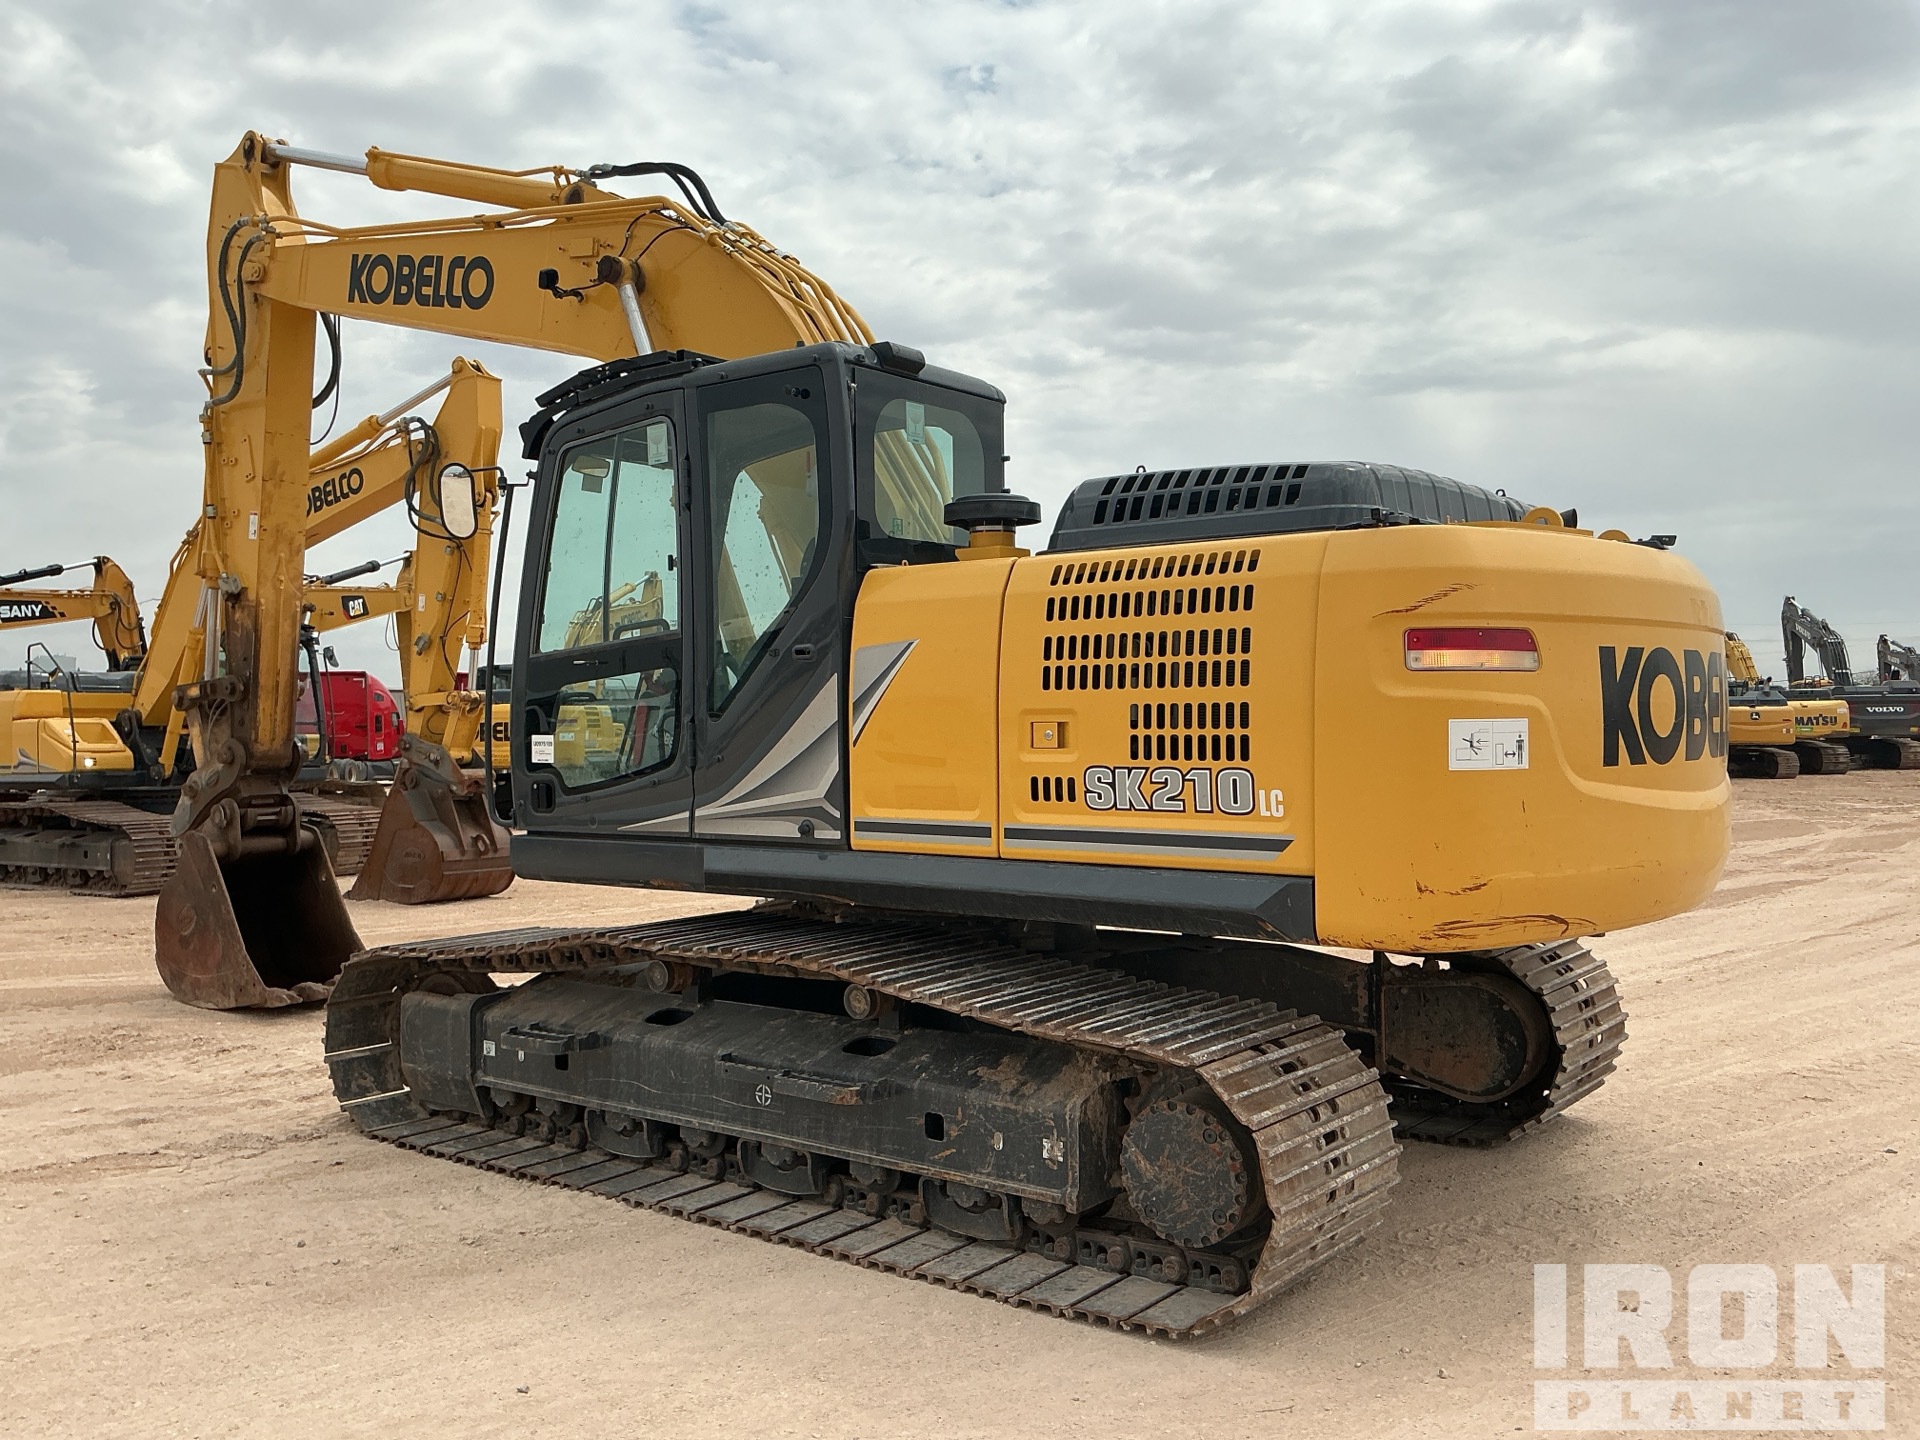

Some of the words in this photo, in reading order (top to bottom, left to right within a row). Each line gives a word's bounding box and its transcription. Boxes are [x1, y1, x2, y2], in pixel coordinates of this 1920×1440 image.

[348, 254, 494, 310] KOBELCO
[0, 604, 42, 618] SANY
[349, 598, 364, 616] CAT
[1599, 646, 1728, 767] KOBEL
[1084, 765, 1256, 815] SK210
[1258, 789, 1285, 818] LC
